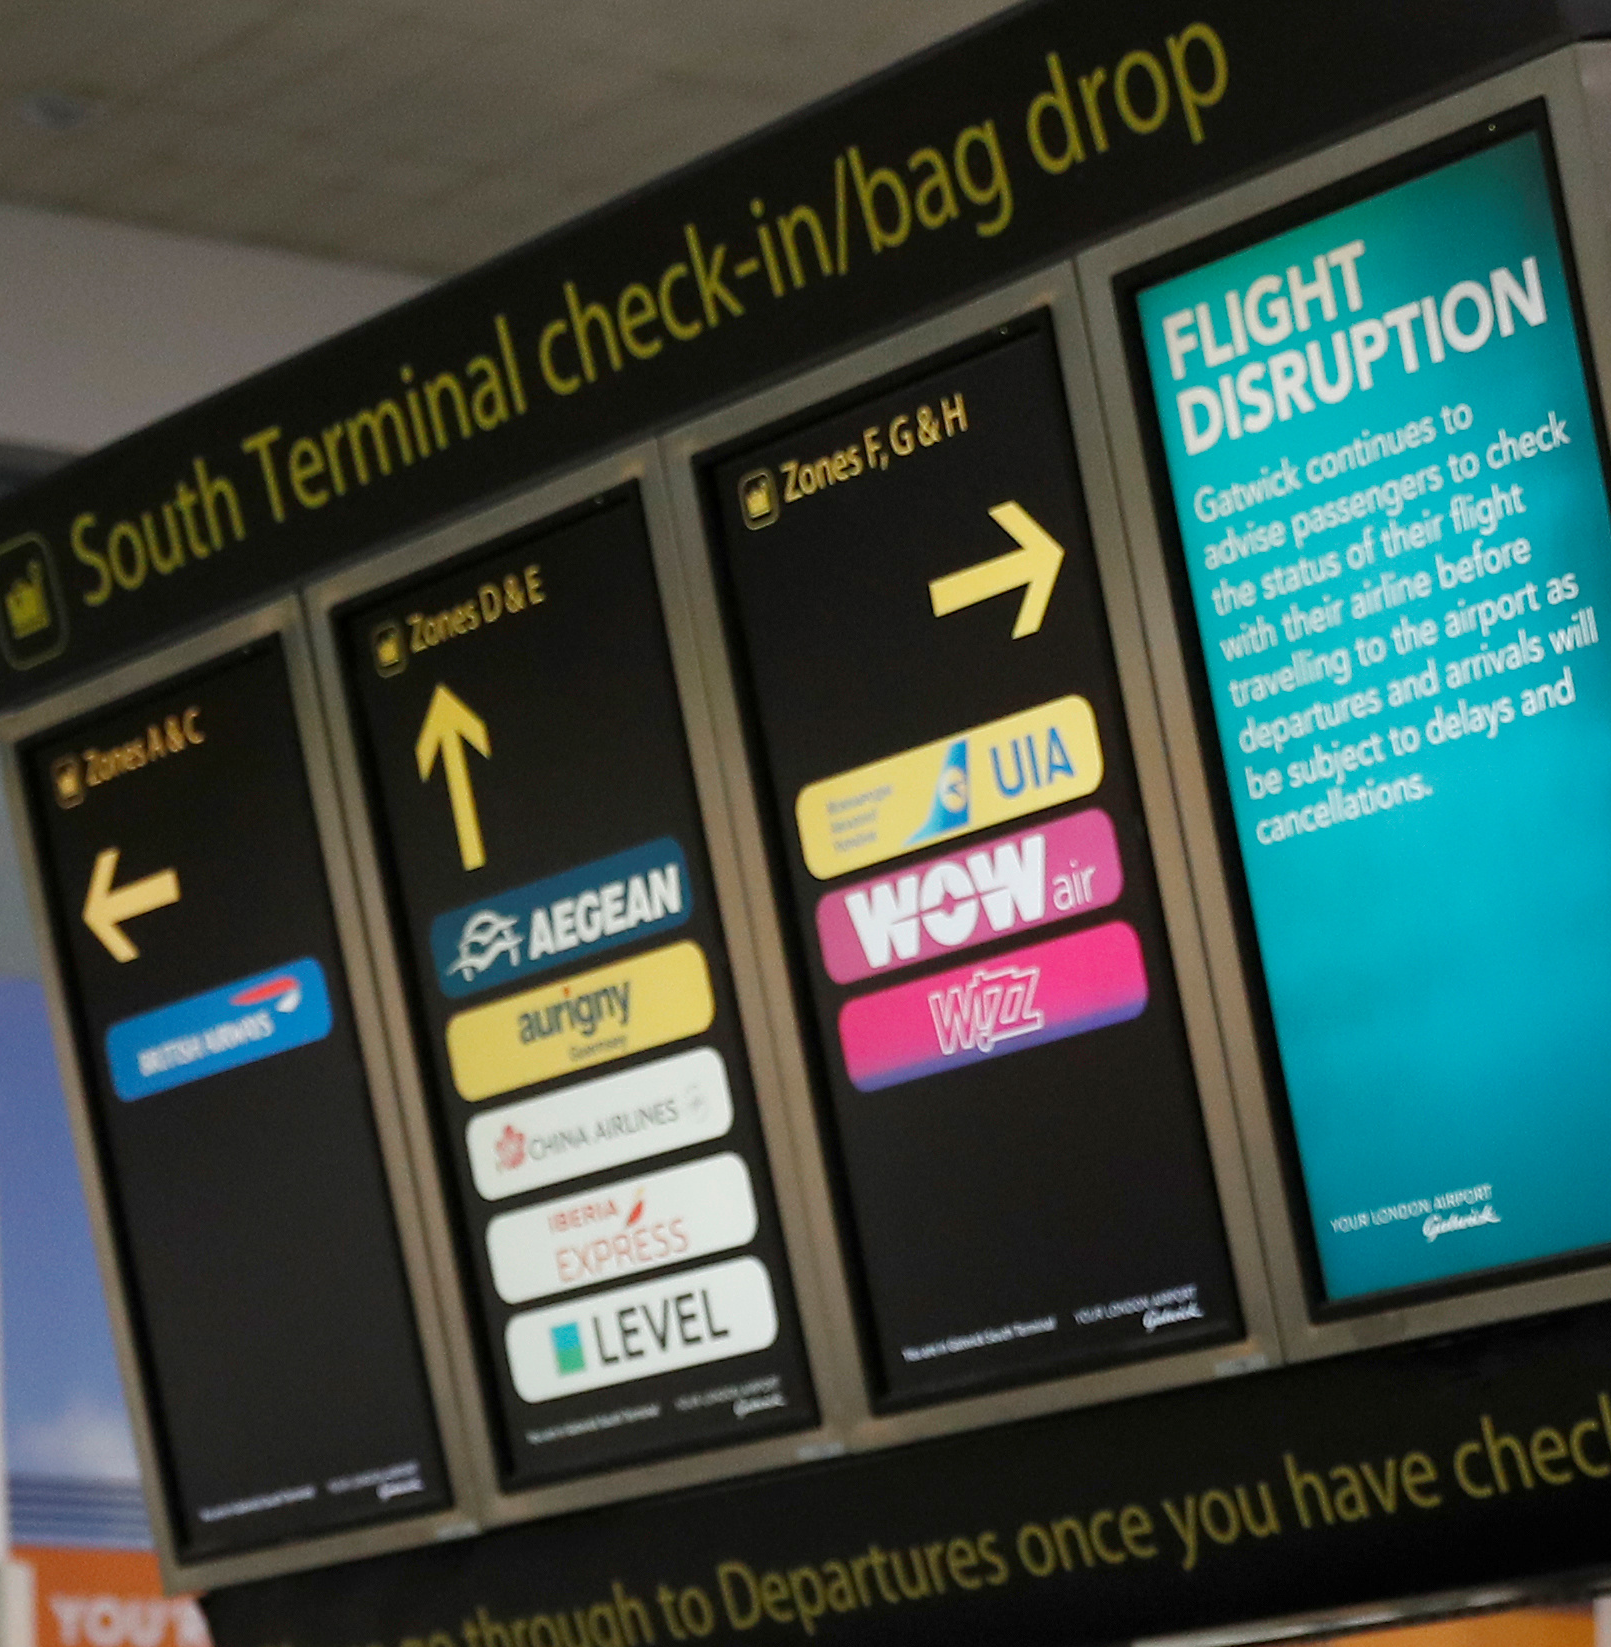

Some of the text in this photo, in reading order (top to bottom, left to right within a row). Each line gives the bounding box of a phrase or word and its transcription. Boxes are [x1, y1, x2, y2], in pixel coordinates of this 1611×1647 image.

[70, 22, 1229, 606] South Terminal check-in/bag drop
[1161, 241, 1365, 381] FLIGHT
[1176, 256, 1548, 455] DISRUPTION
[780, 442, 862, 503] Zones
[889, 414, 915, 456] G
[916, 403, 941, 447] &
[941, 392, 968, 434] H
[1193, 403, 1473, 524] Gatwick continues to
[1203, 411, 1570, 572] advise passengers to check
[1213, 480, 1525, 617] the status of their flight
[1220, 536, 1531, 662] with their airline before
[406, 565, 545, 654] Zones D & E
[1228, 572, 1580, 708] travelling to the airport as
[1238, 607, 1600, 755] departures and arrivals will
[1245, 667, 1577, 800] be subject to delays and
[83, 739, 147, 787] Zones
[991, 726, 1075, 798] UIA
[1256, 770, 1433, 846] cancellations.
[529, 862, 682, 960] AEGEAN
[844, 833, 1096, 969] WOW air
[520, 976, 630, 1044] aurigny
[529, 1100, 678, 1160] CHINA AIRLINES
[549, 1199, 618, 1233] IBERIA
[556, 1219, 689, 1282] EXPRESS
[1330, 1183, 1492, 1233] YOUR LONDON AIRPORT
[594, 1289, 729, 1365] LEVEL
[658, 1583, 716, 1640] to
[717, 1532, 1006, 1635] Departures
[1015, 1503, 1155, 1578] once
[1162, 1478, 1278, 1569] you
[1287, 1452, 1442, 1529] have
